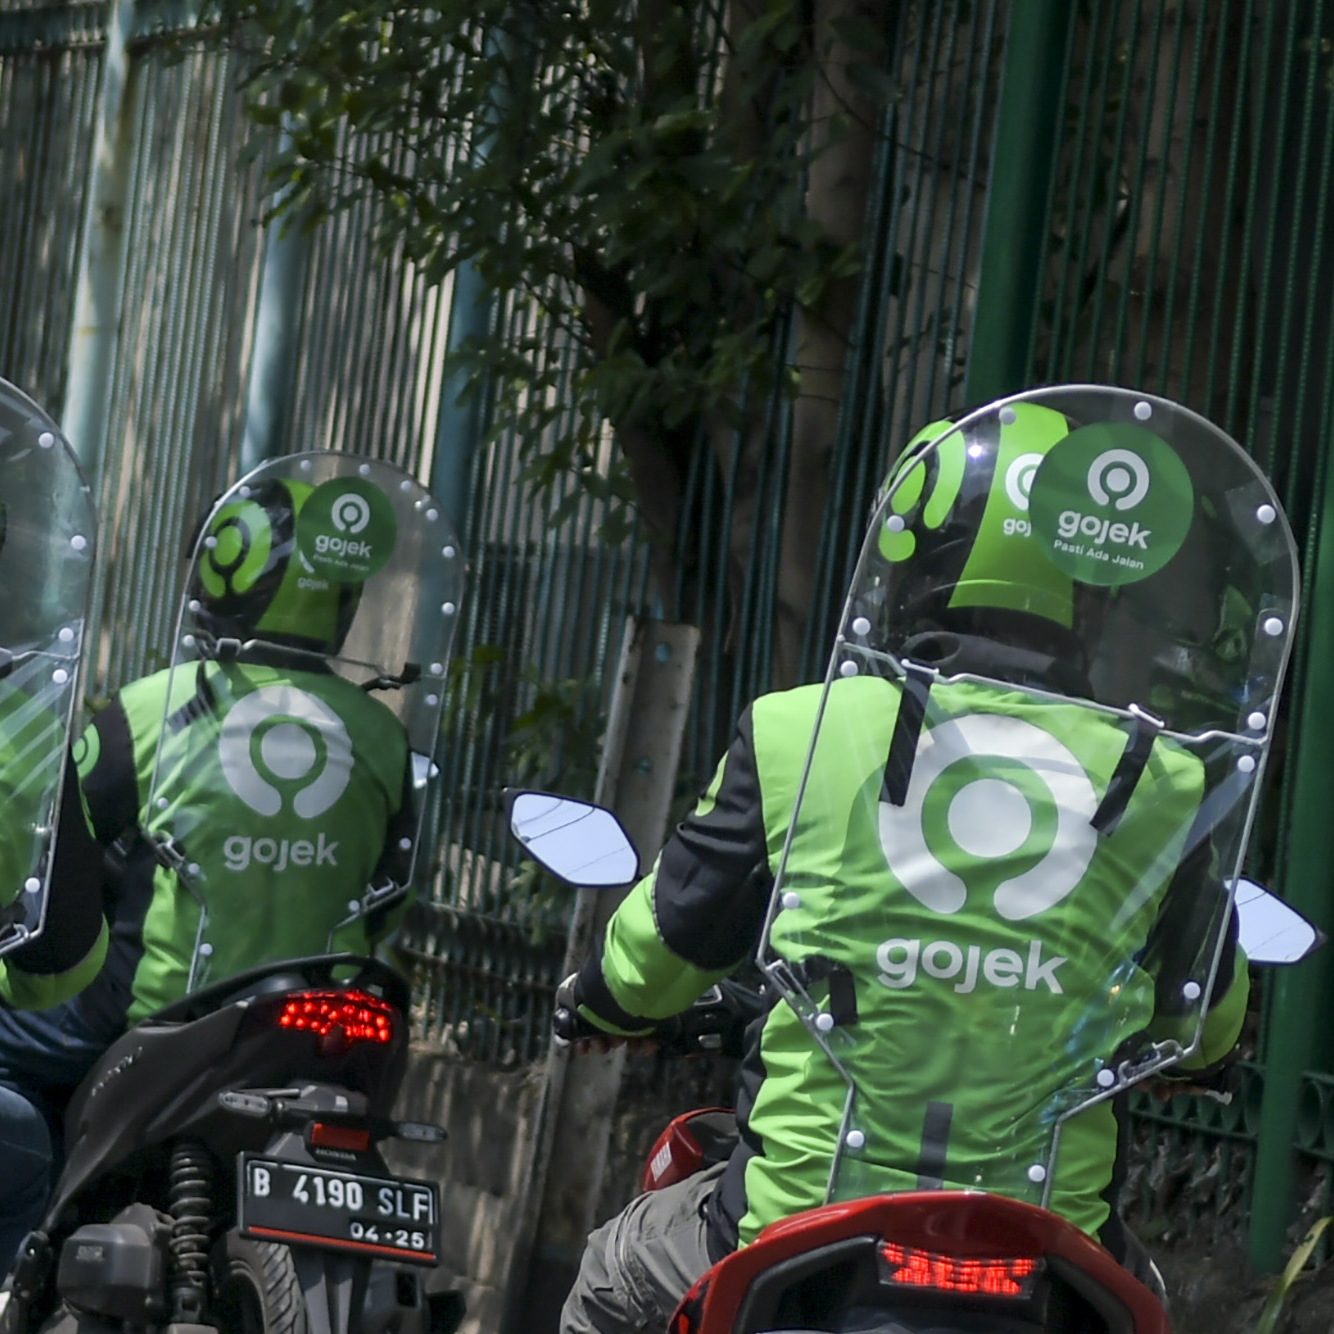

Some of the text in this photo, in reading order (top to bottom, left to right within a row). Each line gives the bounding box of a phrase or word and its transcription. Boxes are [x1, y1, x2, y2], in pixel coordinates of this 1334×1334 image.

[315, 534, 372, 558] gojek
[1003, 518, 1031, 537] goj
[1058, 510, 1152, 549] gojek
[1053, 539, 1144, 570] Pasti Ada Jalan
[224, 832, 339, 872] gojek
[876, 938, 1068, 994] gojek
[254, 1168, 428, 1220] B 4190 SLF
